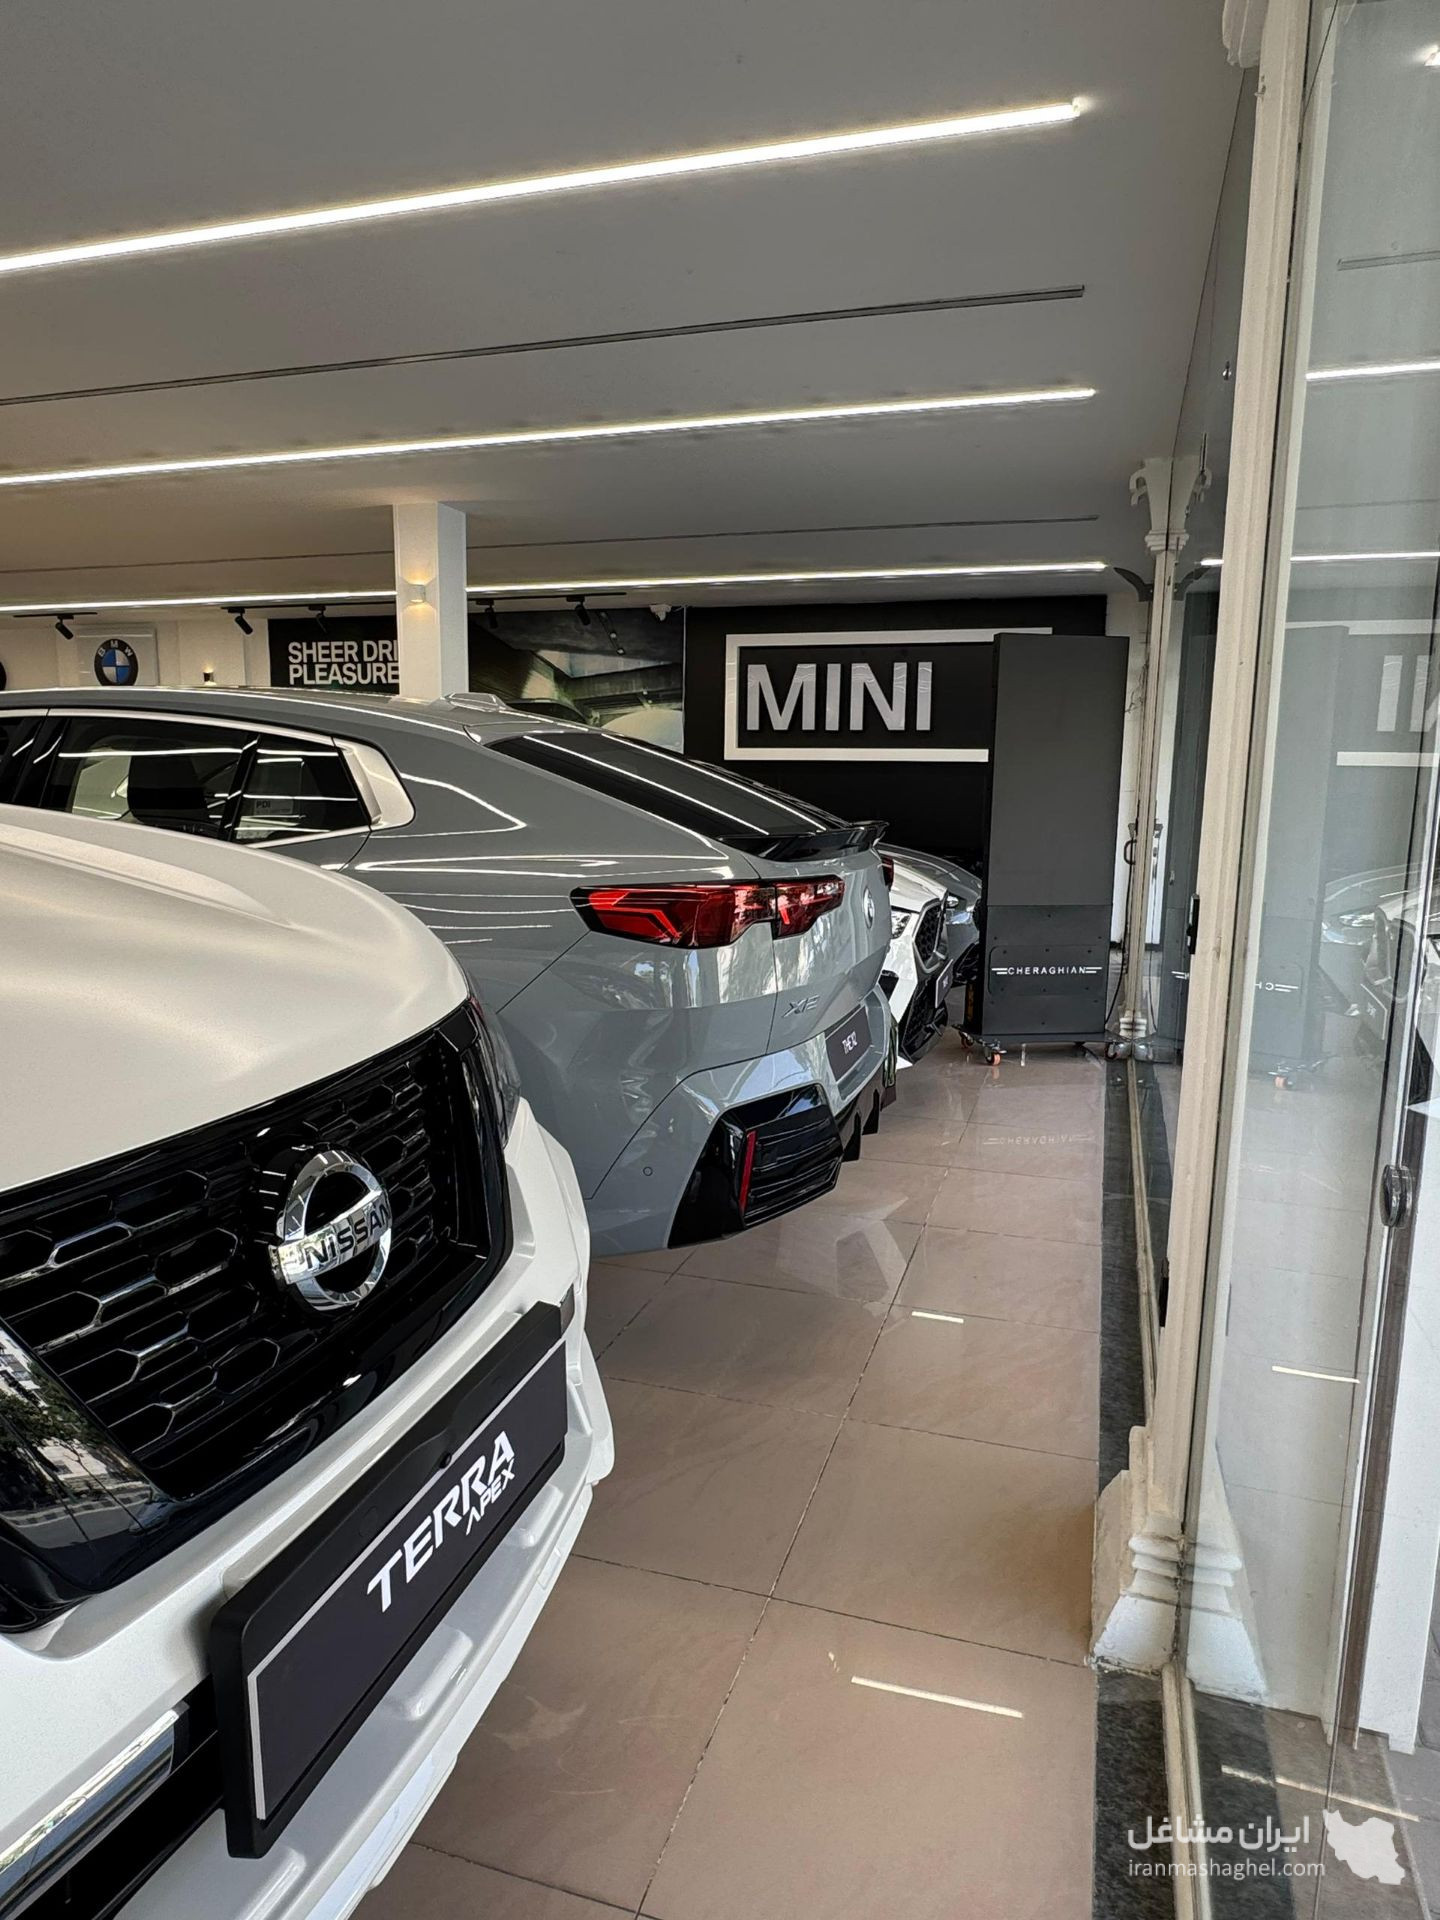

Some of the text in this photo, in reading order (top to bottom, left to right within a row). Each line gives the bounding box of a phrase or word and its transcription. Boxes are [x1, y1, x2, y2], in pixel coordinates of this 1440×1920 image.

[98, 640, 133, 657] BMW
[288, 640, 398, 664] SHEER DRI
[289, 663, 399, 685] PLEASURE
[746, 661, 932, 731] MINI
[1007, 966, 1086, 975] CHERAGHIAN
[466, 1458, 516, 1536] APEX
[367, 1431, 515, 1613] TERRA
